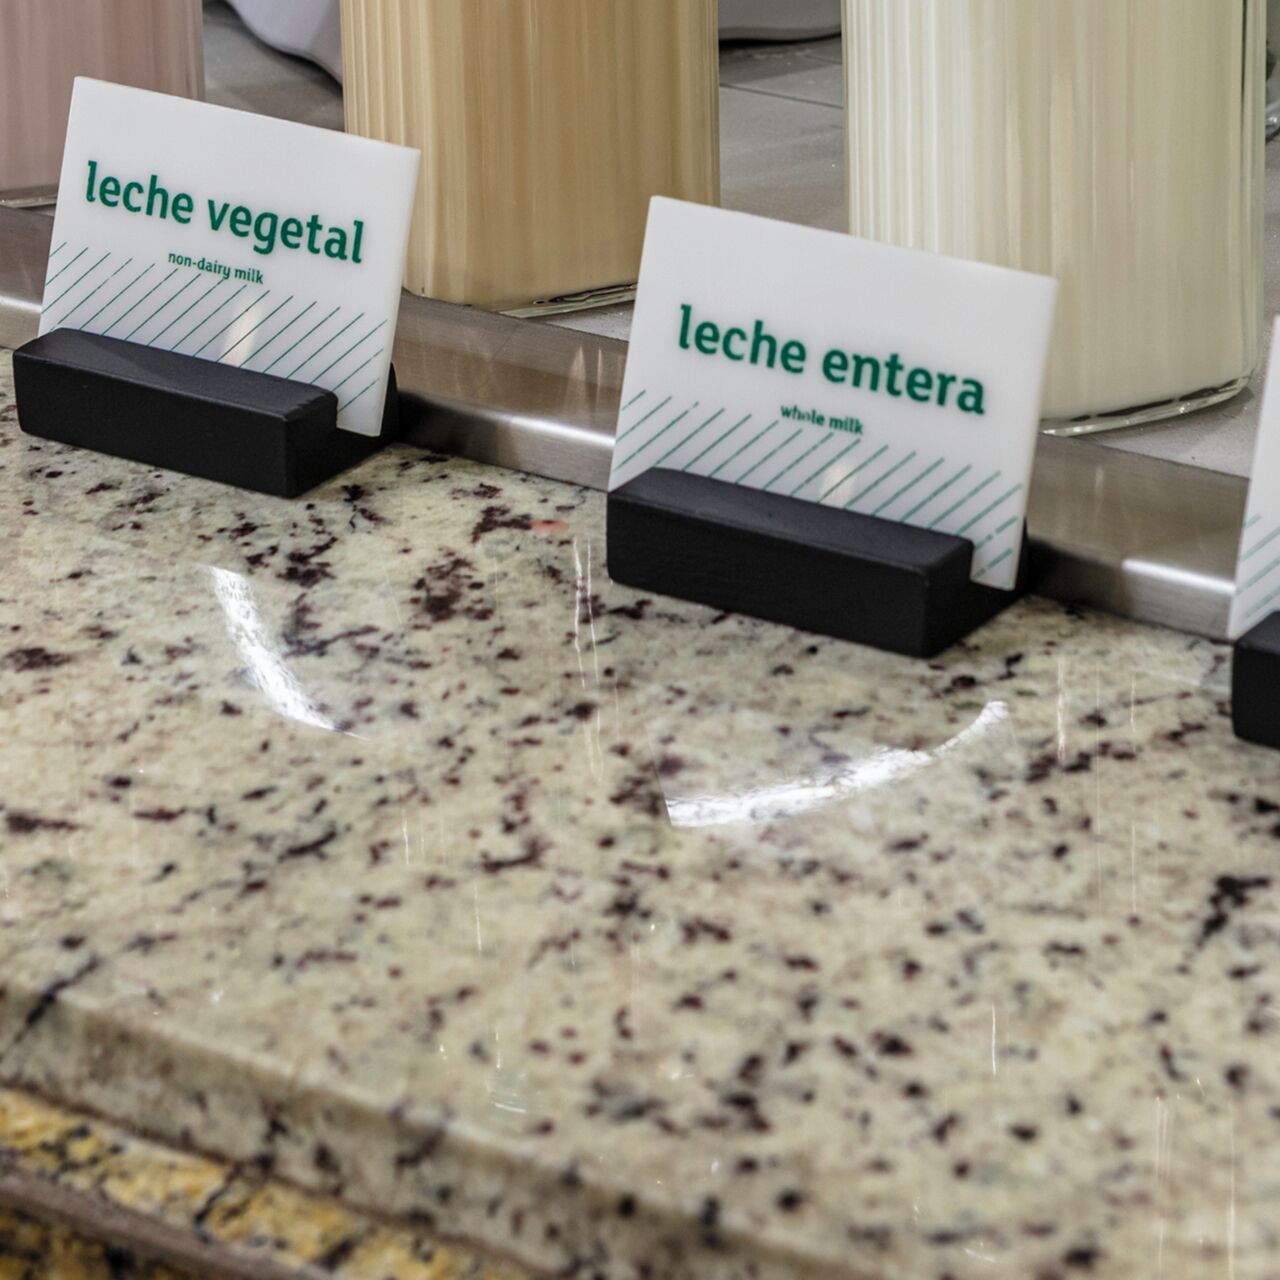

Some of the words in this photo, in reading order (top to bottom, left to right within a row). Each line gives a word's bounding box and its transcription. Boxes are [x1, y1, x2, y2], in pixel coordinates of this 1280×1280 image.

[84, 158, 195, 225] leche
[206, 198, 366, 265] vegetal
[167, 251, 232, 282] non-dairy
[233, 266, 265, 286] milk
[677, 302, 807, 375] leche
[820, 347, 987, 417] entera
[779, 404, 826, 427] whole
[828, 416, 864, 436] milk
